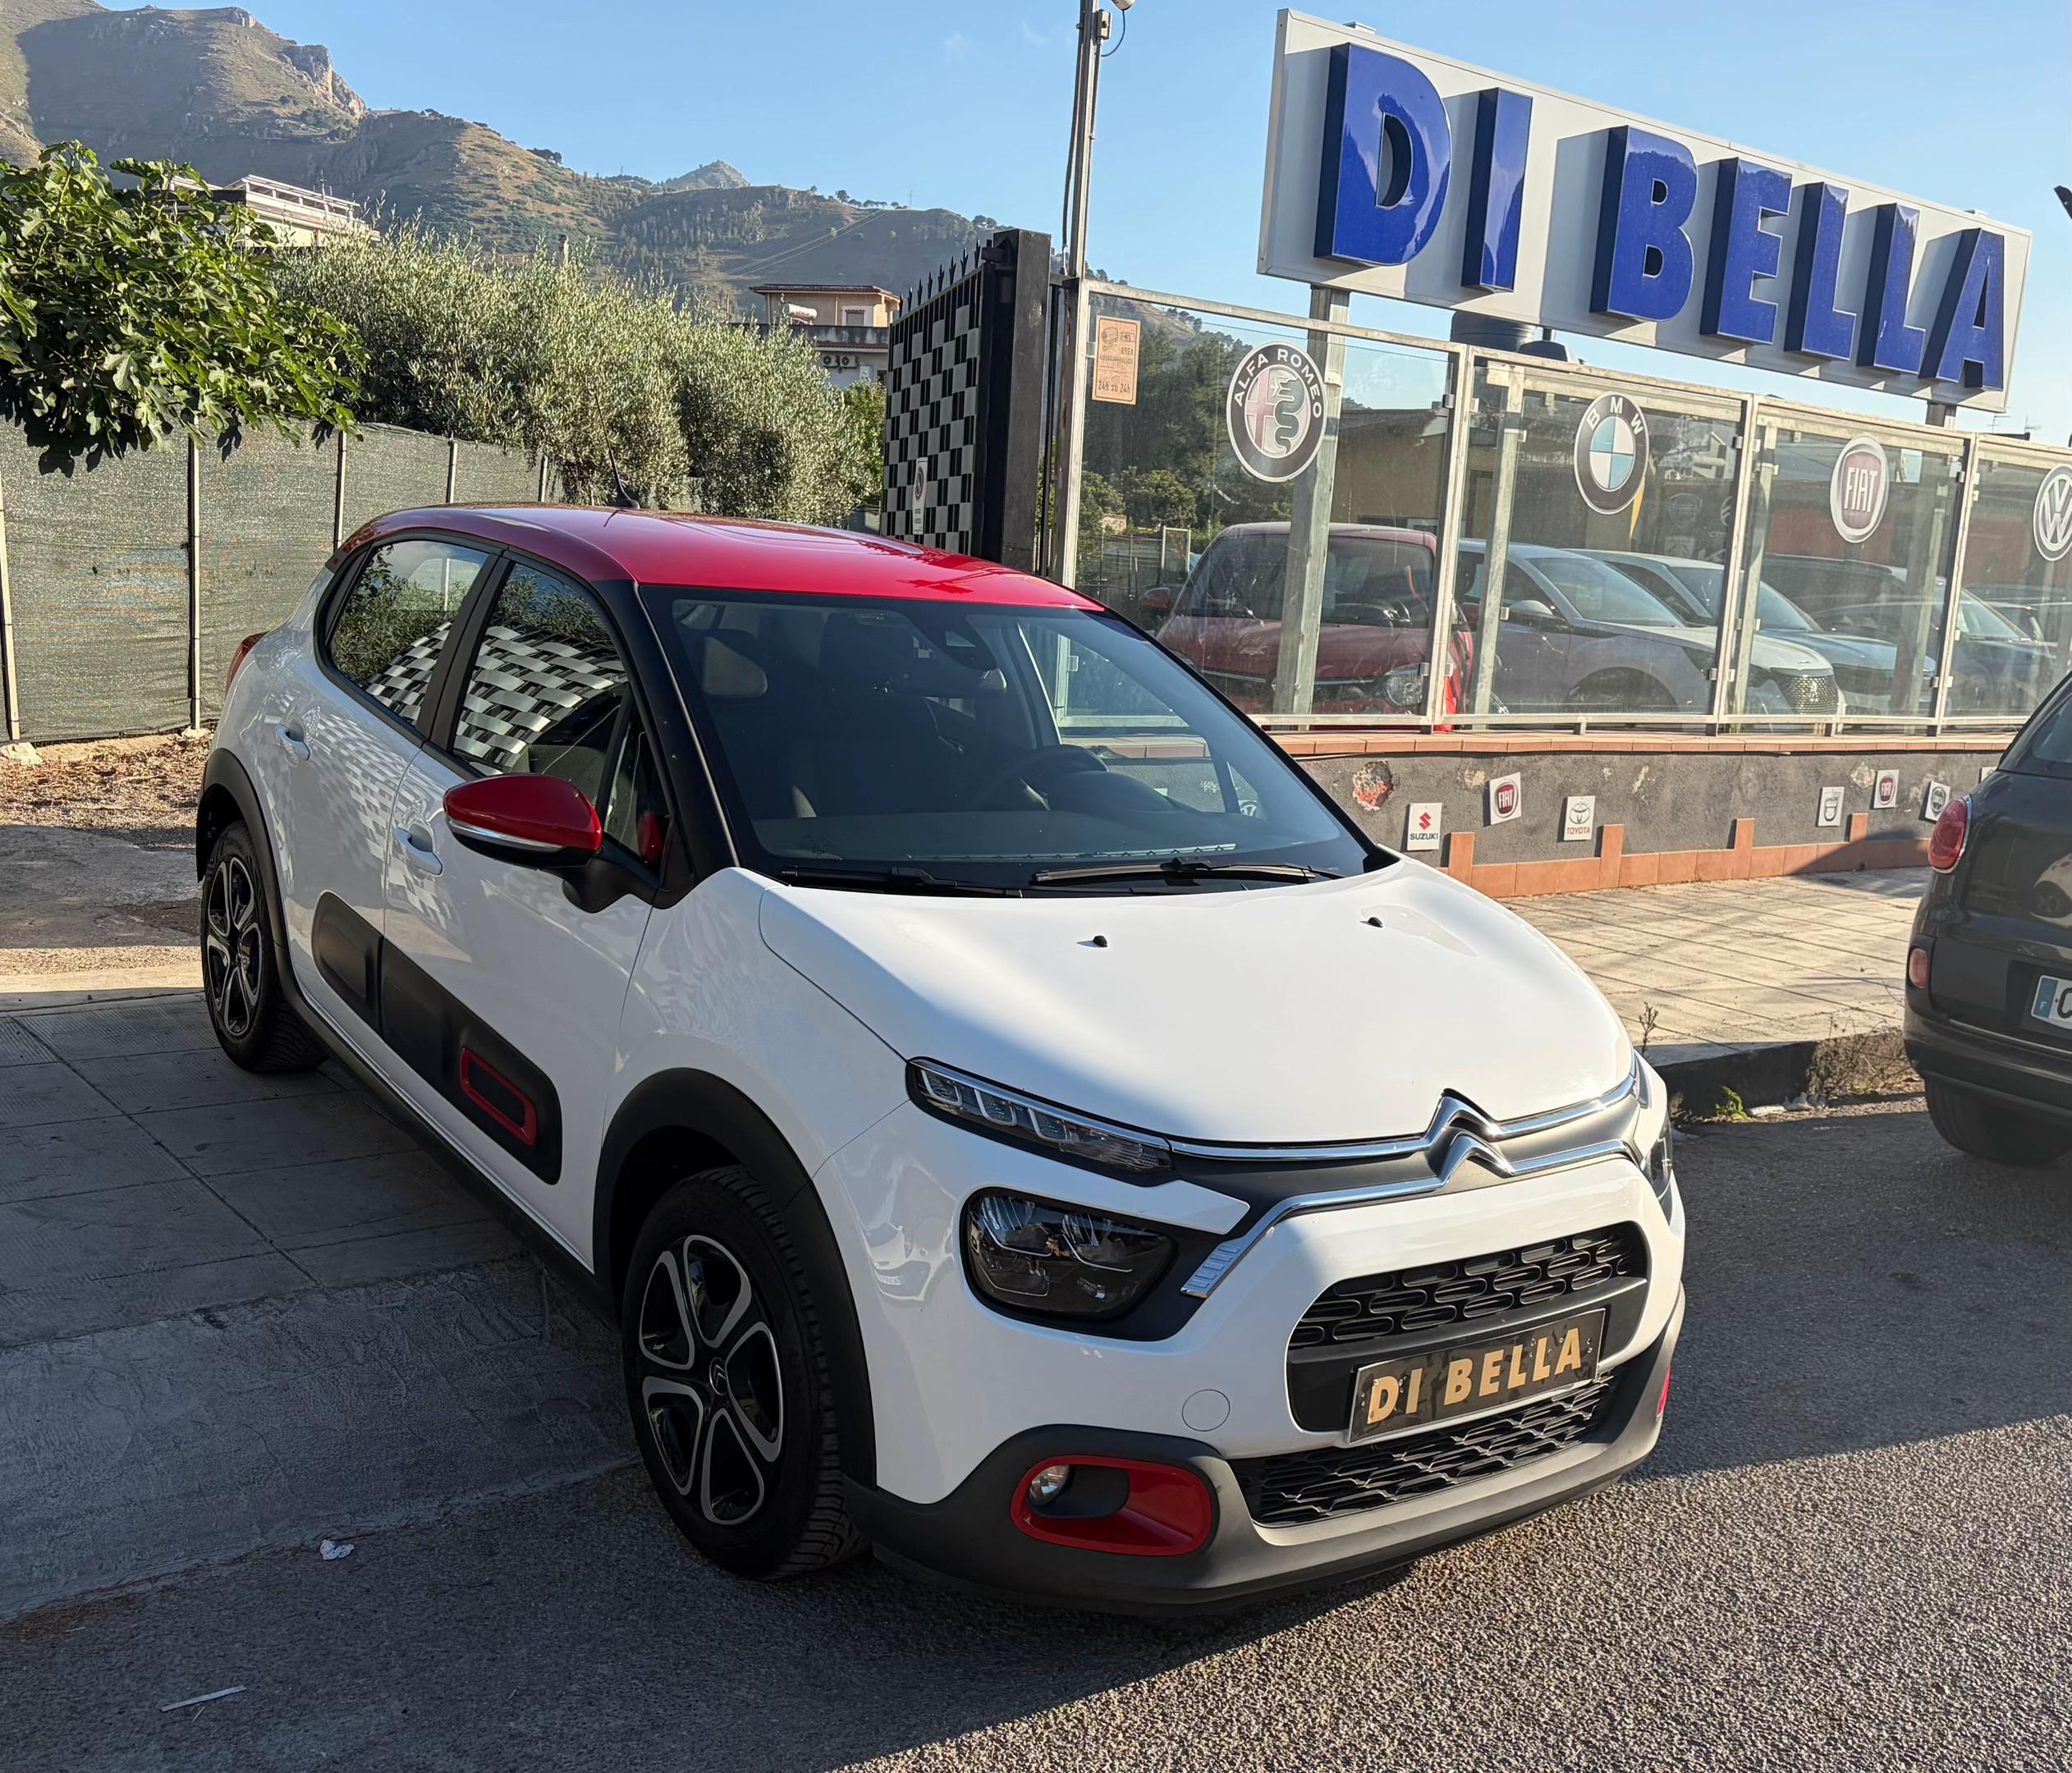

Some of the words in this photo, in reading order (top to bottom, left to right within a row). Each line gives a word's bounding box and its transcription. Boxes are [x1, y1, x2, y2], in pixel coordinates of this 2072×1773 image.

[1314, 43, 1533, 292] DI
[1590, 125, 2005, 390] BELLA
[1234, 353, 1269, 407] ALFA
[1277, 348, 1323, 419] ROMEO
[1586, 396, 1643, 435] BMW
[1844, 466, 1878, 513] FIAT
[1498, 789, 1514, 809] FIAT
[1410, 832, 1439, 841] SUZUKI
[1567, 827, 1591, 835] TOYOTA
[1367, 1368, 1423, 1424] DI
[1444, 1327, 1582, 1405] BELLA
